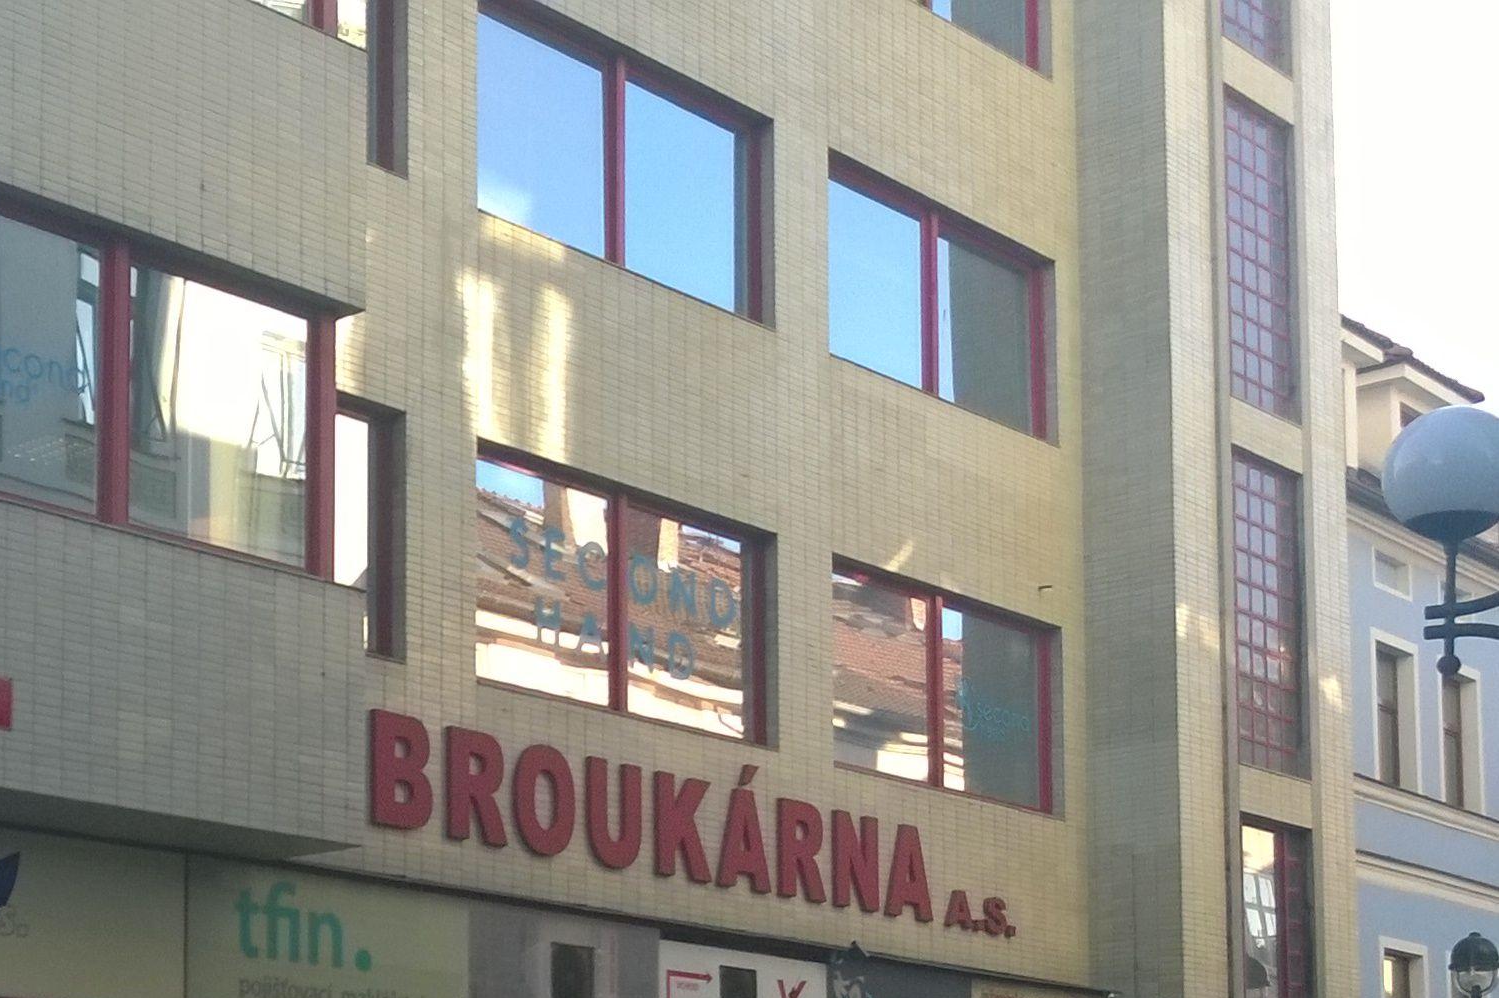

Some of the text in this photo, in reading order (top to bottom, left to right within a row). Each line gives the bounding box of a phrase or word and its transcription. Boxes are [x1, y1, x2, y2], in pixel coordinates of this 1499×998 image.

[509, 516, 738, 629] SECOND
[533, 597, 696, 681] HAND
[368, 708, 934, 922] BROUKÁRNA
